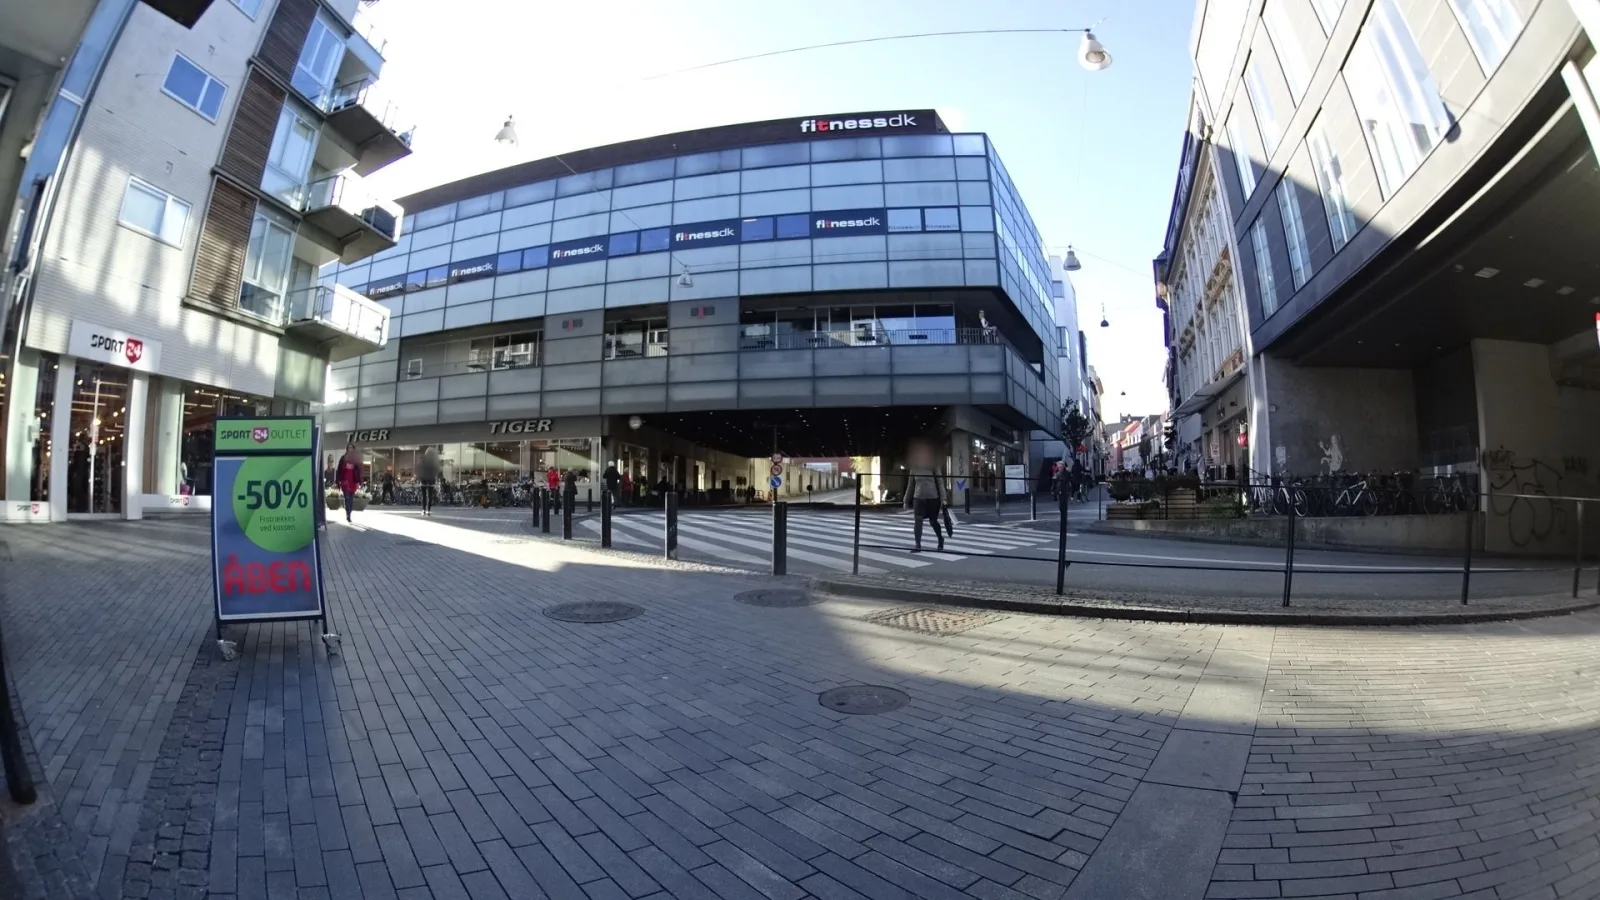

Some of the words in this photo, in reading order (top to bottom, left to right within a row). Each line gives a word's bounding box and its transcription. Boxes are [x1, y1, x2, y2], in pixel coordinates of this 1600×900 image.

[801, 114, 916, 132] fitnessdk
[816, 217, 880, 228] fitnessdk
[675, 228, 735, 241] fitnessdk
[553, 244, 603, 258] fitnessdk
[369, 281, 403, 295] finessdk
[91, 334, 124, 353] SPORT
[127, 342, 141, 358] 24
[489, 419, 552, 434] TIGER
[220, 430, 251, 439] SPORT
[254, 429, 268, 439] 24
[270, 429, 306, 439] OUTLET
[345, 429, 389, 442] TIGER
[237, 479, 308, 510] -50%
